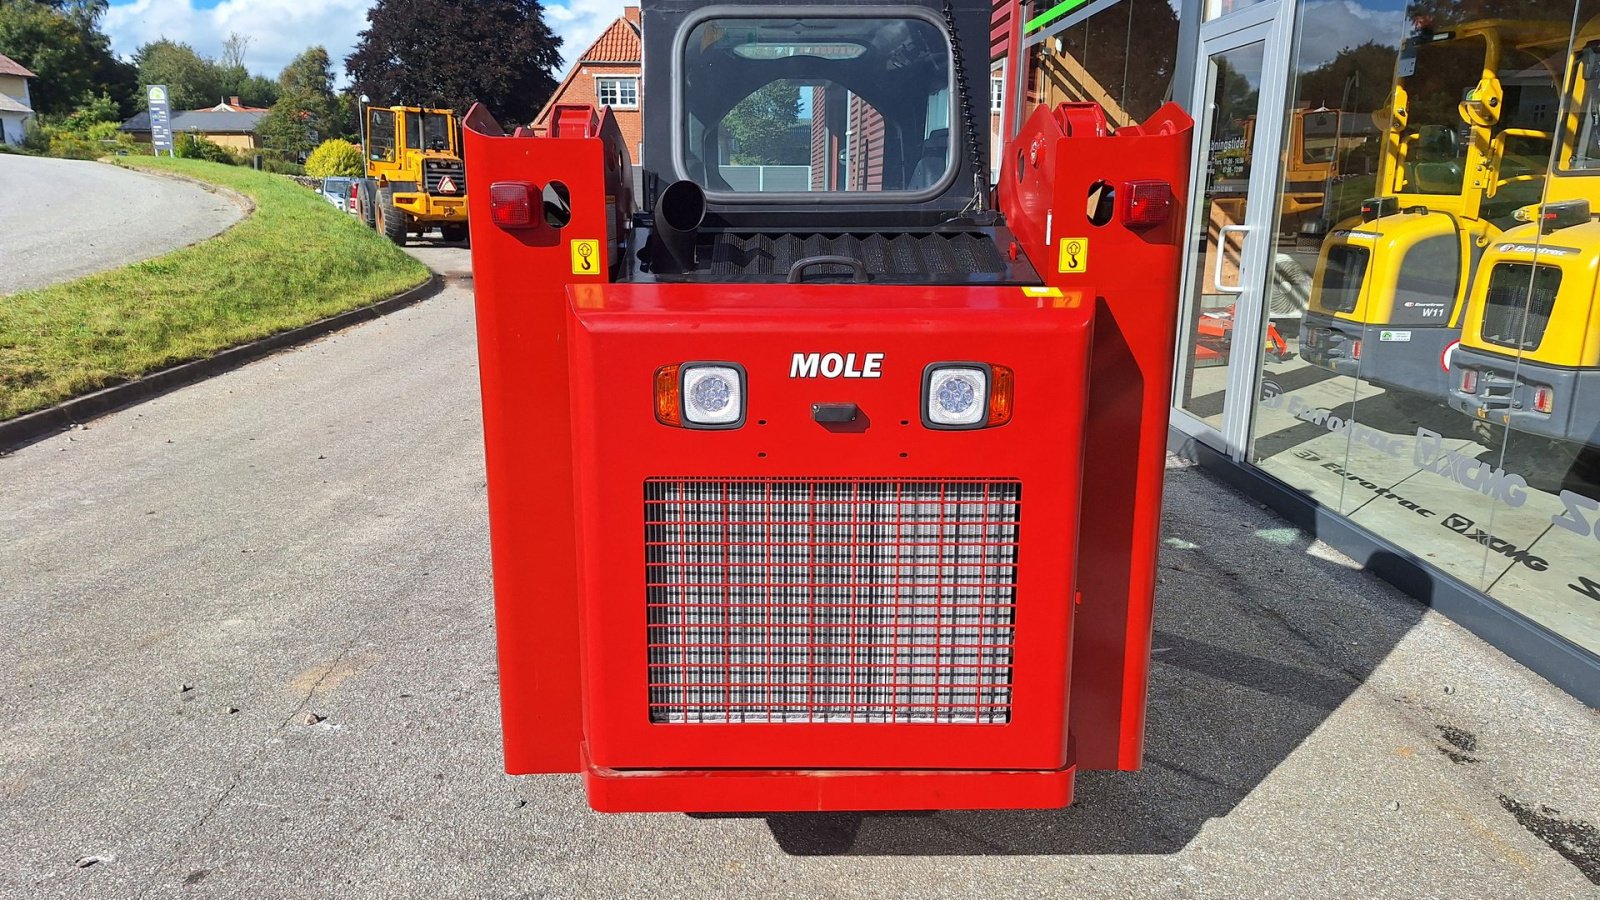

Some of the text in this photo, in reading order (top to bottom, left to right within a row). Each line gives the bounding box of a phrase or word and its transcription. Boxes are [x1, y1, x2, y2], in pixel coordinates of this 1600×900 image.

[1515, 245, 1567, 256] Eurotrac
[1422, 308, 1444, 317] W11
[789, 352, 885, 379] MOLE
[1287, 395, 1405, 458] Eurotrac
[1434, 449, 1528, 508] XCMG
[1319, 462, 1550, 572] Eurotrac XCMG
